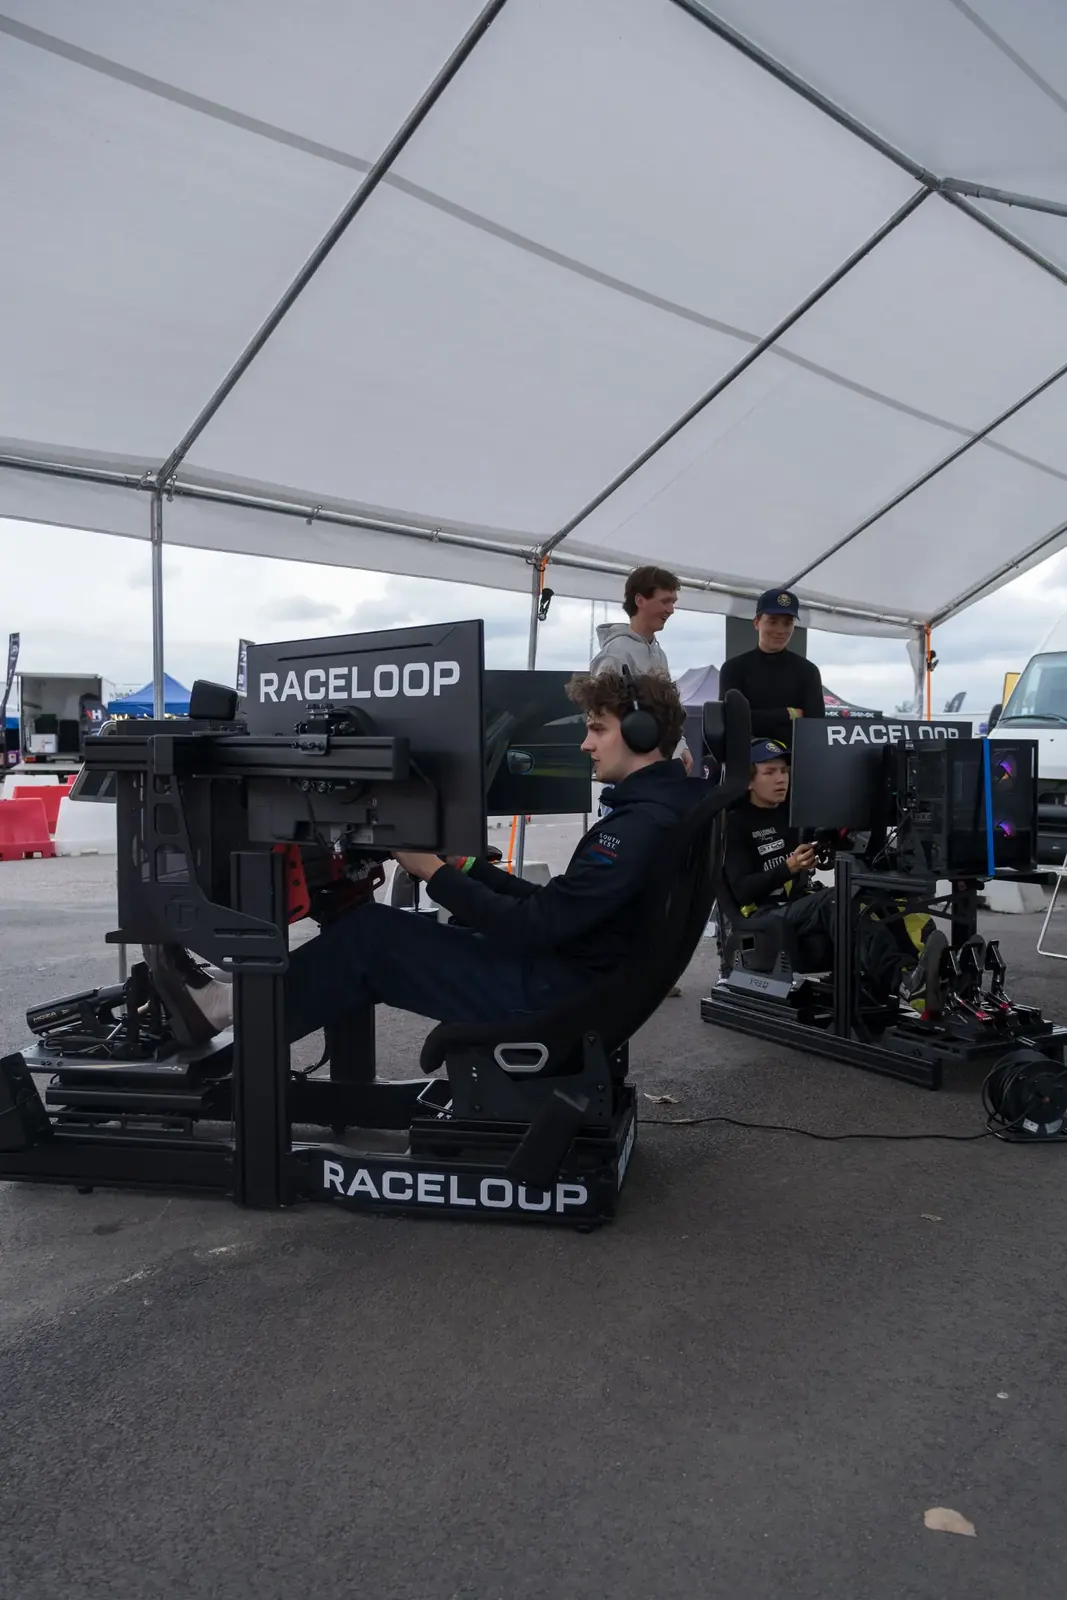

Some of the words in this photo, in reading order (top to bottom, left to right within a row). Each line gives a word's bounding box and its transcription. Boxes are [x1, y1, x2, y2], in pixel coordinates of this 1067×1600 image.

[259, 661, 460, 702] RACELOOP
[599, 833, 620, 845] SOUTH
[323, 1160, 588, 1212] RACELOOP
